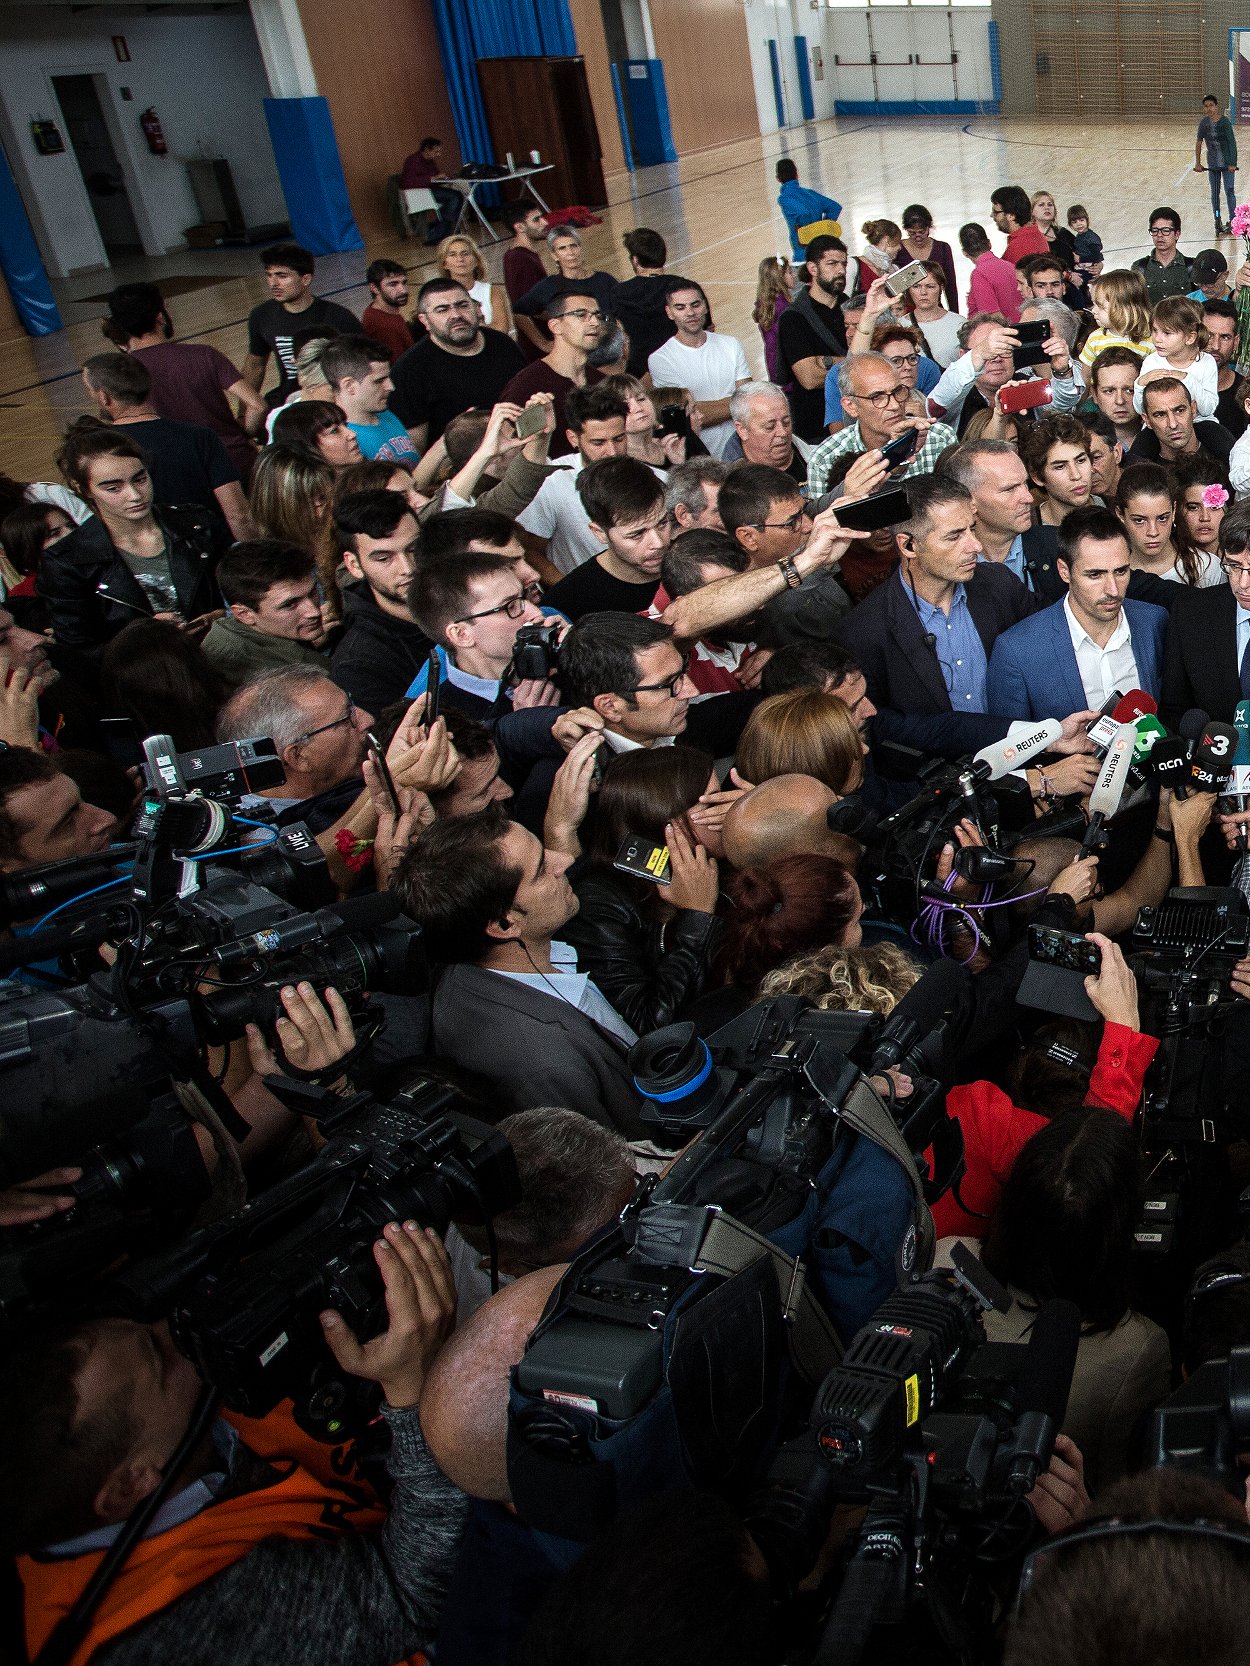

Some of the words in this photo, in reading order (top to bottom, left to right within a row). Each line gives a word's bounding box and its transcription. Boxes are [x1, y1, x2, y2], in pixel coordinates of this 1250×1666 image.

[1098, 726, 1114, 736] press
[1101, 717, 1120, 730] europa
[1015, 729, 1048, 753] REUTERS
[1210, 735, 1230, 756] 3
[1101, 753, 1121, 788] REUTERS
[1158, 758, 1183, 771] acn
[286, 831, 310, 851] LIVE
[982, 857, 1005, 865] Panasonic
